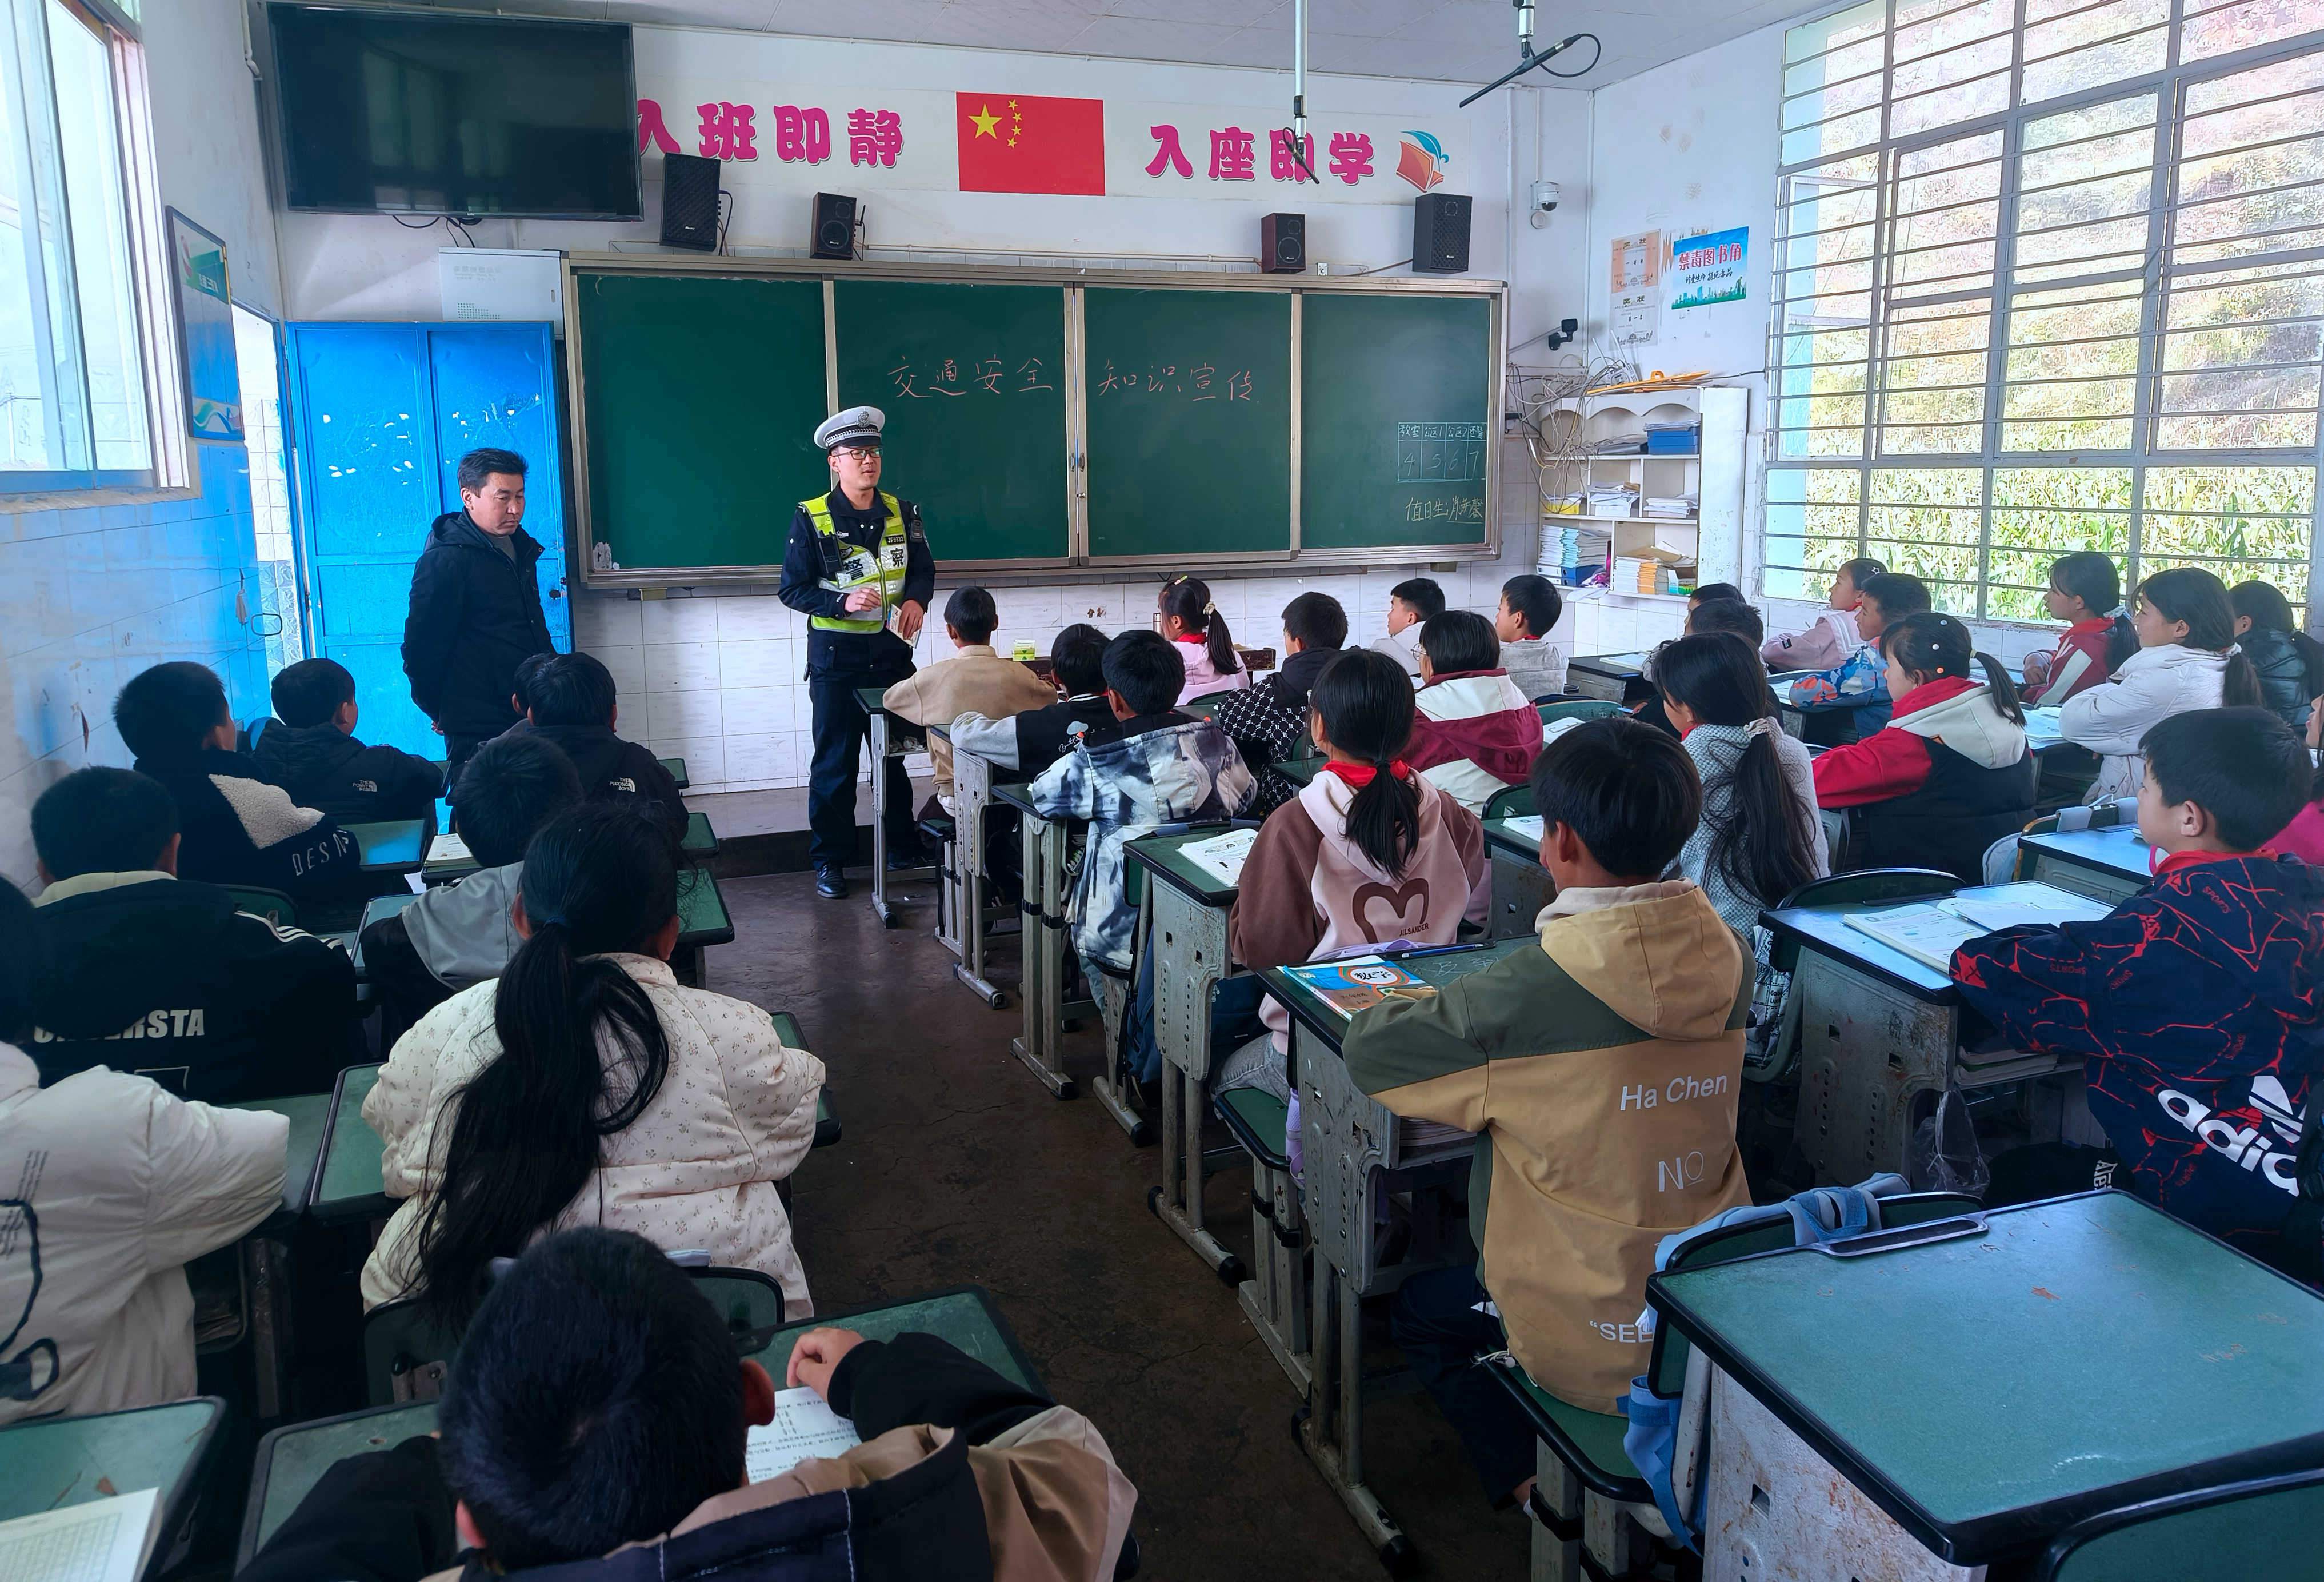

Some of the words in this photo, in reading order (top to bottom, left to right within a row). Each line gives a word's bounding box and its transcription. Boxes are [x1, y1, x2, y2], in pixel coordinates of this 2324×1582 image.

[637, 98, 903, 167] 入班即静
[1145, 124, 1374, 186] 入座即学
[1679, 243, 1741, 271] 禁毒图书角
[1686, 274, 1706, 285] 珍爱生命
[1707, 267, 1733, 281] 拒绝毒品
[888, 355, 1053, 398] 交通安全
[1098, 359, 1255, 401] 知识宣传
[1399, 425, 1421, 437] 教室
[1404, 453, 1415, 476] 4
[1427, 454, 1440, 469] 5
[1449, 449, 1458, 470] 6
[1620, 1084, 1657, 1111] Ha
[1666, 1075, 1727, 1103] Chen
